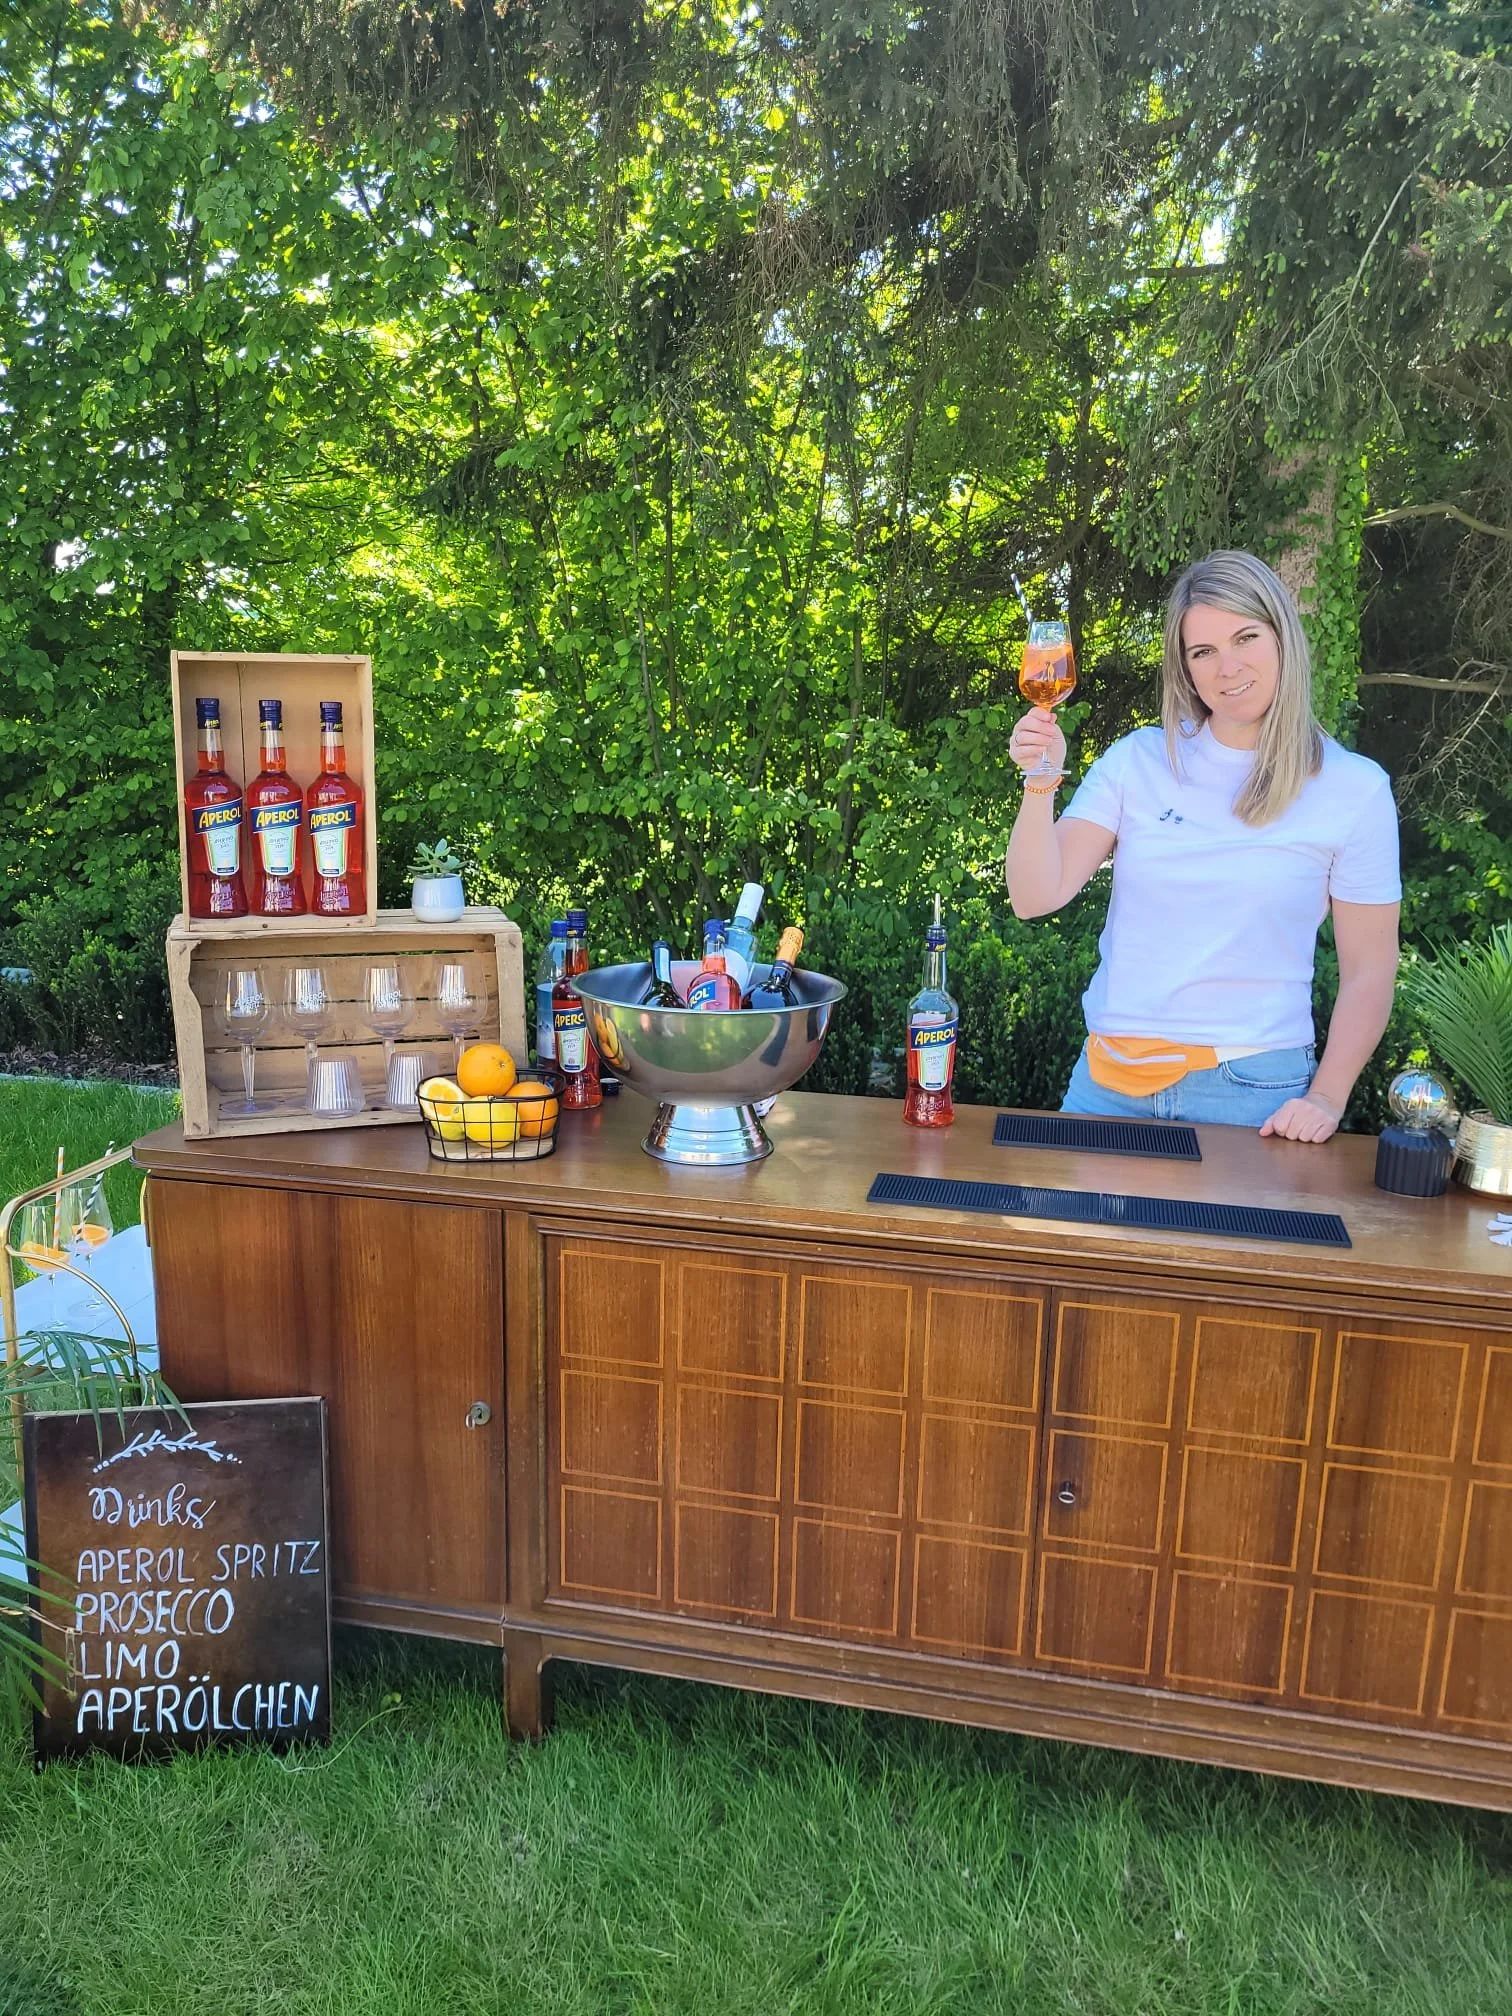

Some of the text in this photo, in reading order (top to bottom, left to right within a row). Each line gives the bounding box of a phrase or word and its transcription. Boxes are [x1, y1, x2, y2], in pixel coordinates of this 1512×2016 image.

[200, 806, 241, 828] APEROL
[256, 807, 299, 828] APEROL
[311, 810, 351, 829] APEROL
[690, 987, 710, 1007] ROL
[555, 1012, 585, 1028] APERO
[915, 1027, 955, 1046] APEROL
[88, 1483, 216, 1529] Drinks
[77, 1541, 322, 1584] APEROL SPRITZ
[75, 1588, 235, 1636] PROSECCO
[80, 1640, 181, 1680] LIMO
[77, 1672, 320, 1734] APERÖLCHEN
